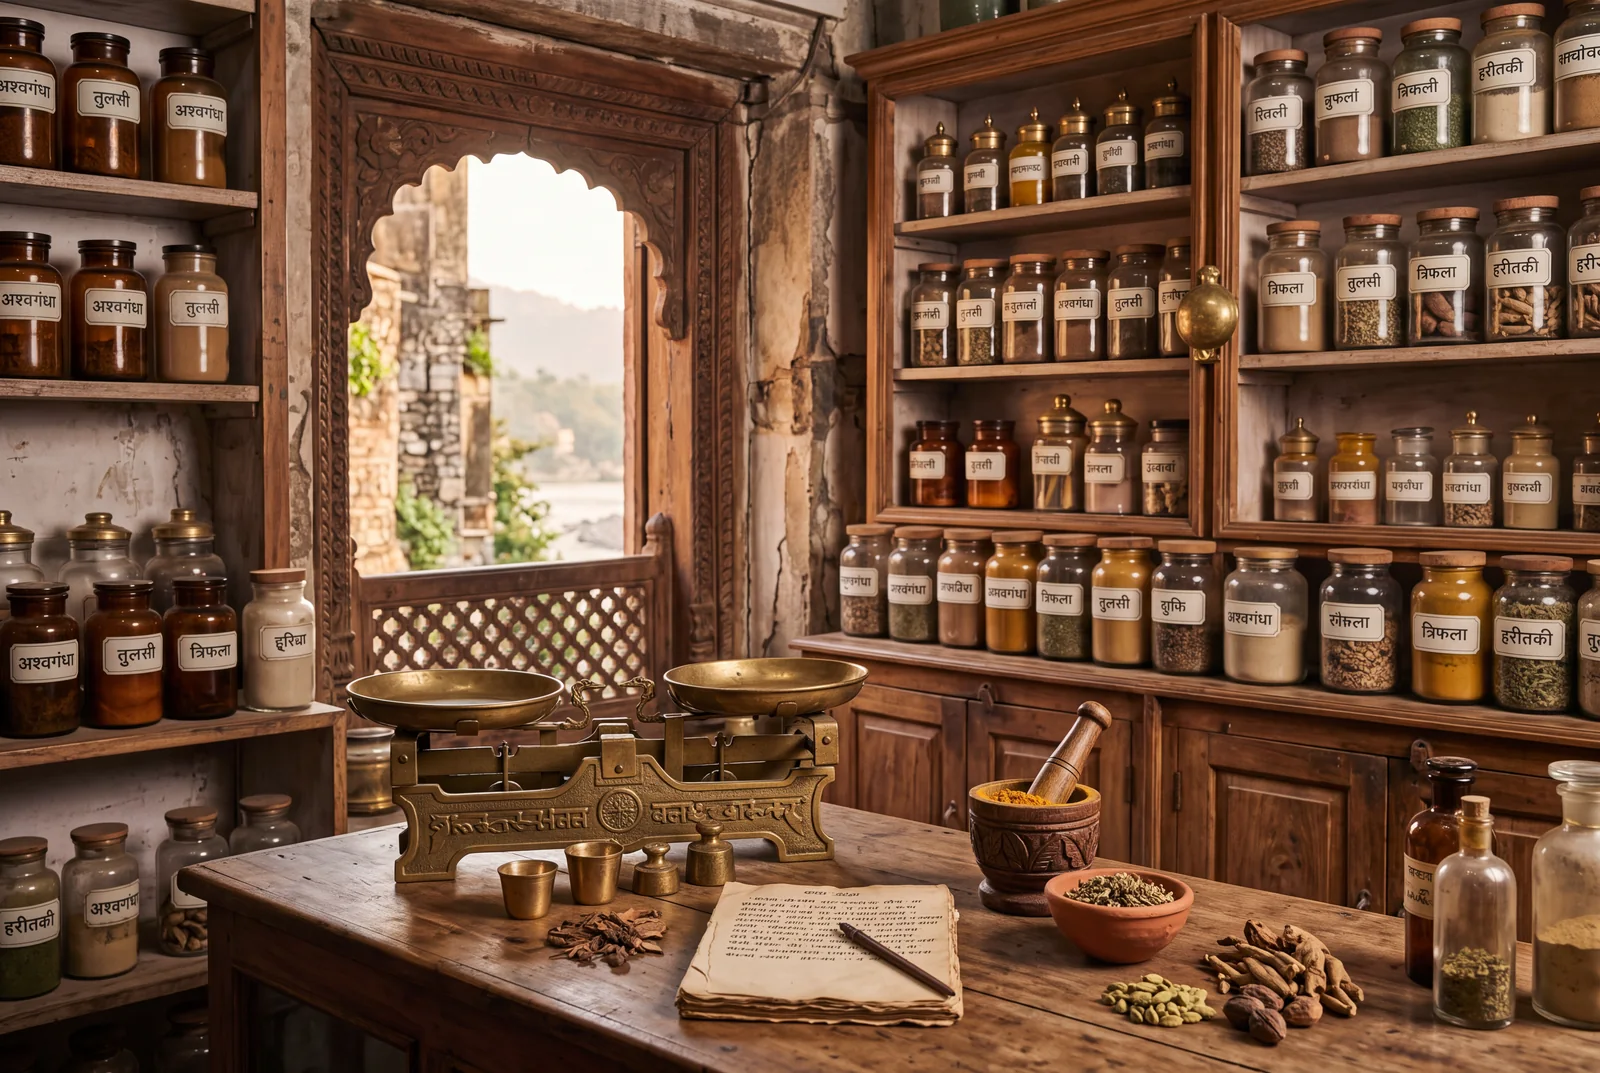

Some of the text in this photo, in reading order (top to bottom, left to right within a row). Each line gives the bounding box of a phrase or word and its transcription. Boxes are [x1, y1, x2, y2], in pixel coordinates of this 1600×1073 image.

[1478, 57, 1523, 81] हरीतकी
[0, 79, 51, 99] अश्वगंधा
[93, 90, 130, 109] तुलसी
[175, 104, 224, 123] अश्वगंधा
[1417, 264, 1457, 281] त्रिफला
[1493, 256, 1539, 278] हरीतकी
[1576, 253, 1600, 274] हरी
[1267, 280, 1304, 295] त्रिफला
[1347, 272, 1381, 293] तुलसी
[2, 291, 57, 309] अश्वगंधा
[93, 298, 144, 315] अश्वगंधा
[185, 299, 220, 318] तुलसी
[1114, 293, 1143, 312] तुलसी
[1041, 589, 1072, 605] त्रिफला
[1098, 594, 1131, 613] तुलसी
[1227, 610, 1273, 626] अश्वगंधा
[1421, 621, 1468, 641] त्रिफला
[1500, 626, 1553, 646] हरीतकी
[117, 642, 156, 667] तुलसी
[189, 642, 231, 660] त्रिफला
[18, 652, 75, 671] अश्वगंधा
[90, 892, 139, 917] अश्वगंधा
[4, 909, 55, 936] हरीतकी
